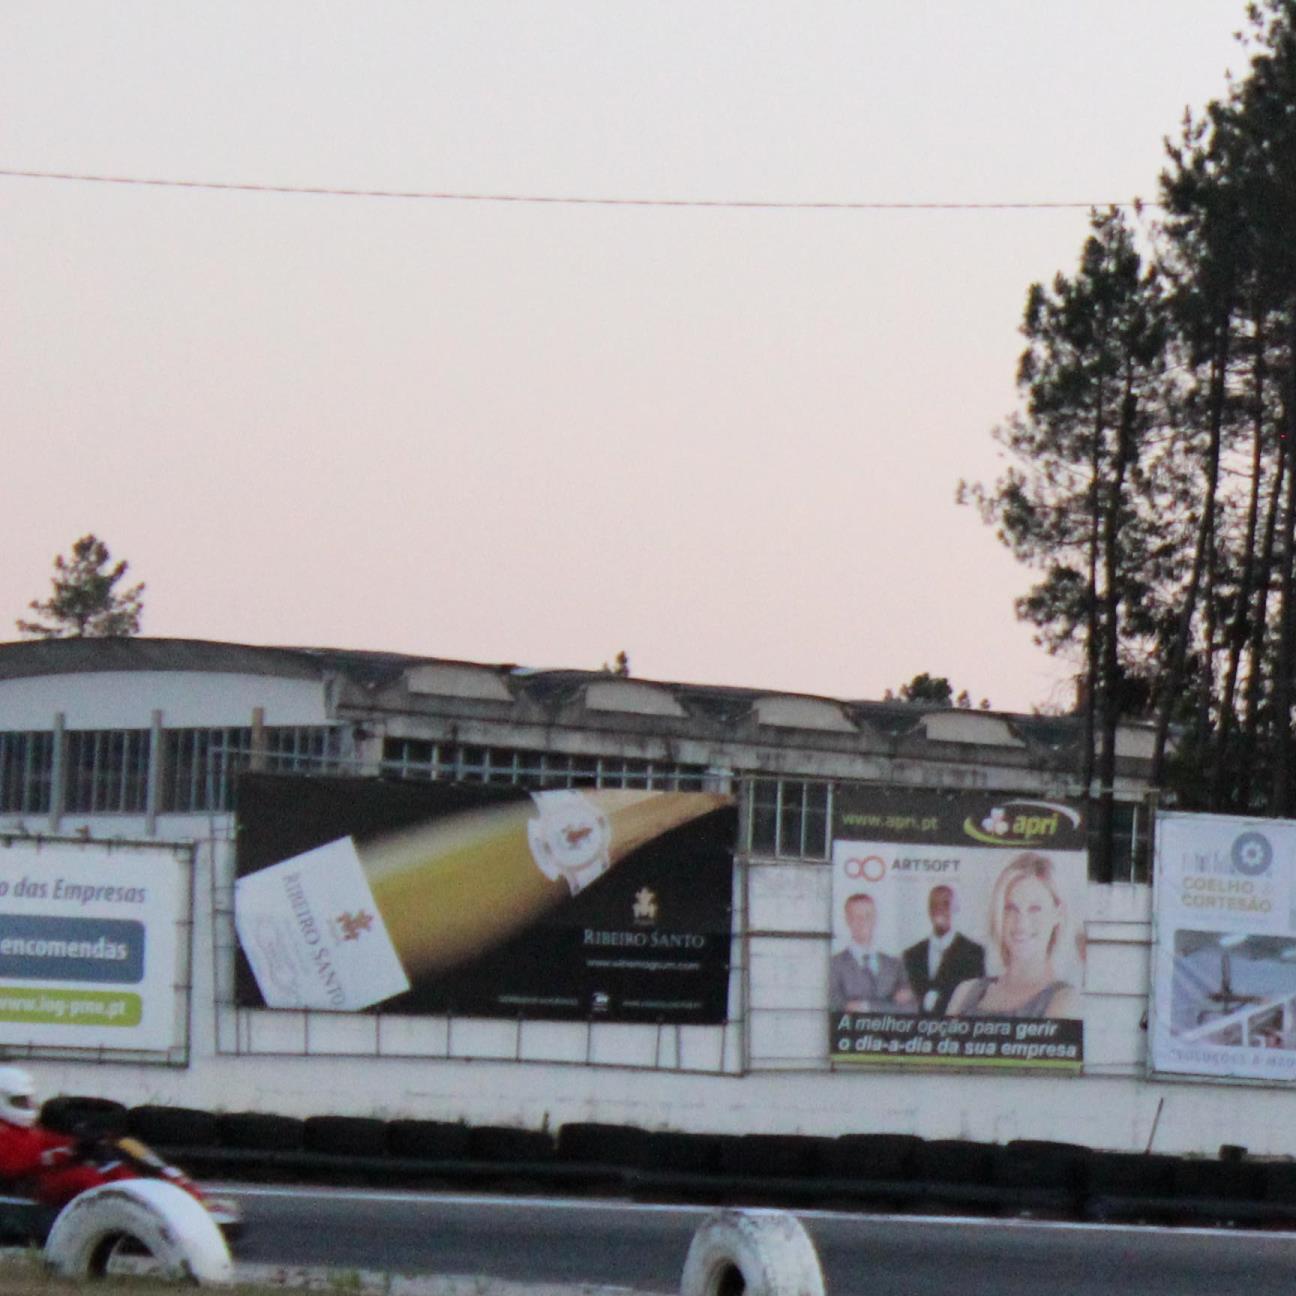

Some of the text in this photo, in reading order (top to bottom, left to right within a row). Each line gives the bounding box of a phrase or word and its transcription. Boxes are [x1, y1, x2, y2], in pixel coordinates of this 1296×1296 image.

[842, 813, 939, 831] www.apri.pt
[1013, 812, 1059, 836] apri
[891, 857, 961, 873] ARTSOFT
[13, 875, 48, 899] das
[52, 878, 147, 906] Empresas
[1183, 876, 1255, 894] COELHO
[1, 936, 128, 961] encomendas
[584, 929, 705, 949] RIBEIRO SANTO
[313, 946, 347, 1007] SANTO
[838, 1015, 1058, 1040] A melhor opção para gerir
[838, 1035, 1077, 1061] o dia-a-dia da sua empresa
